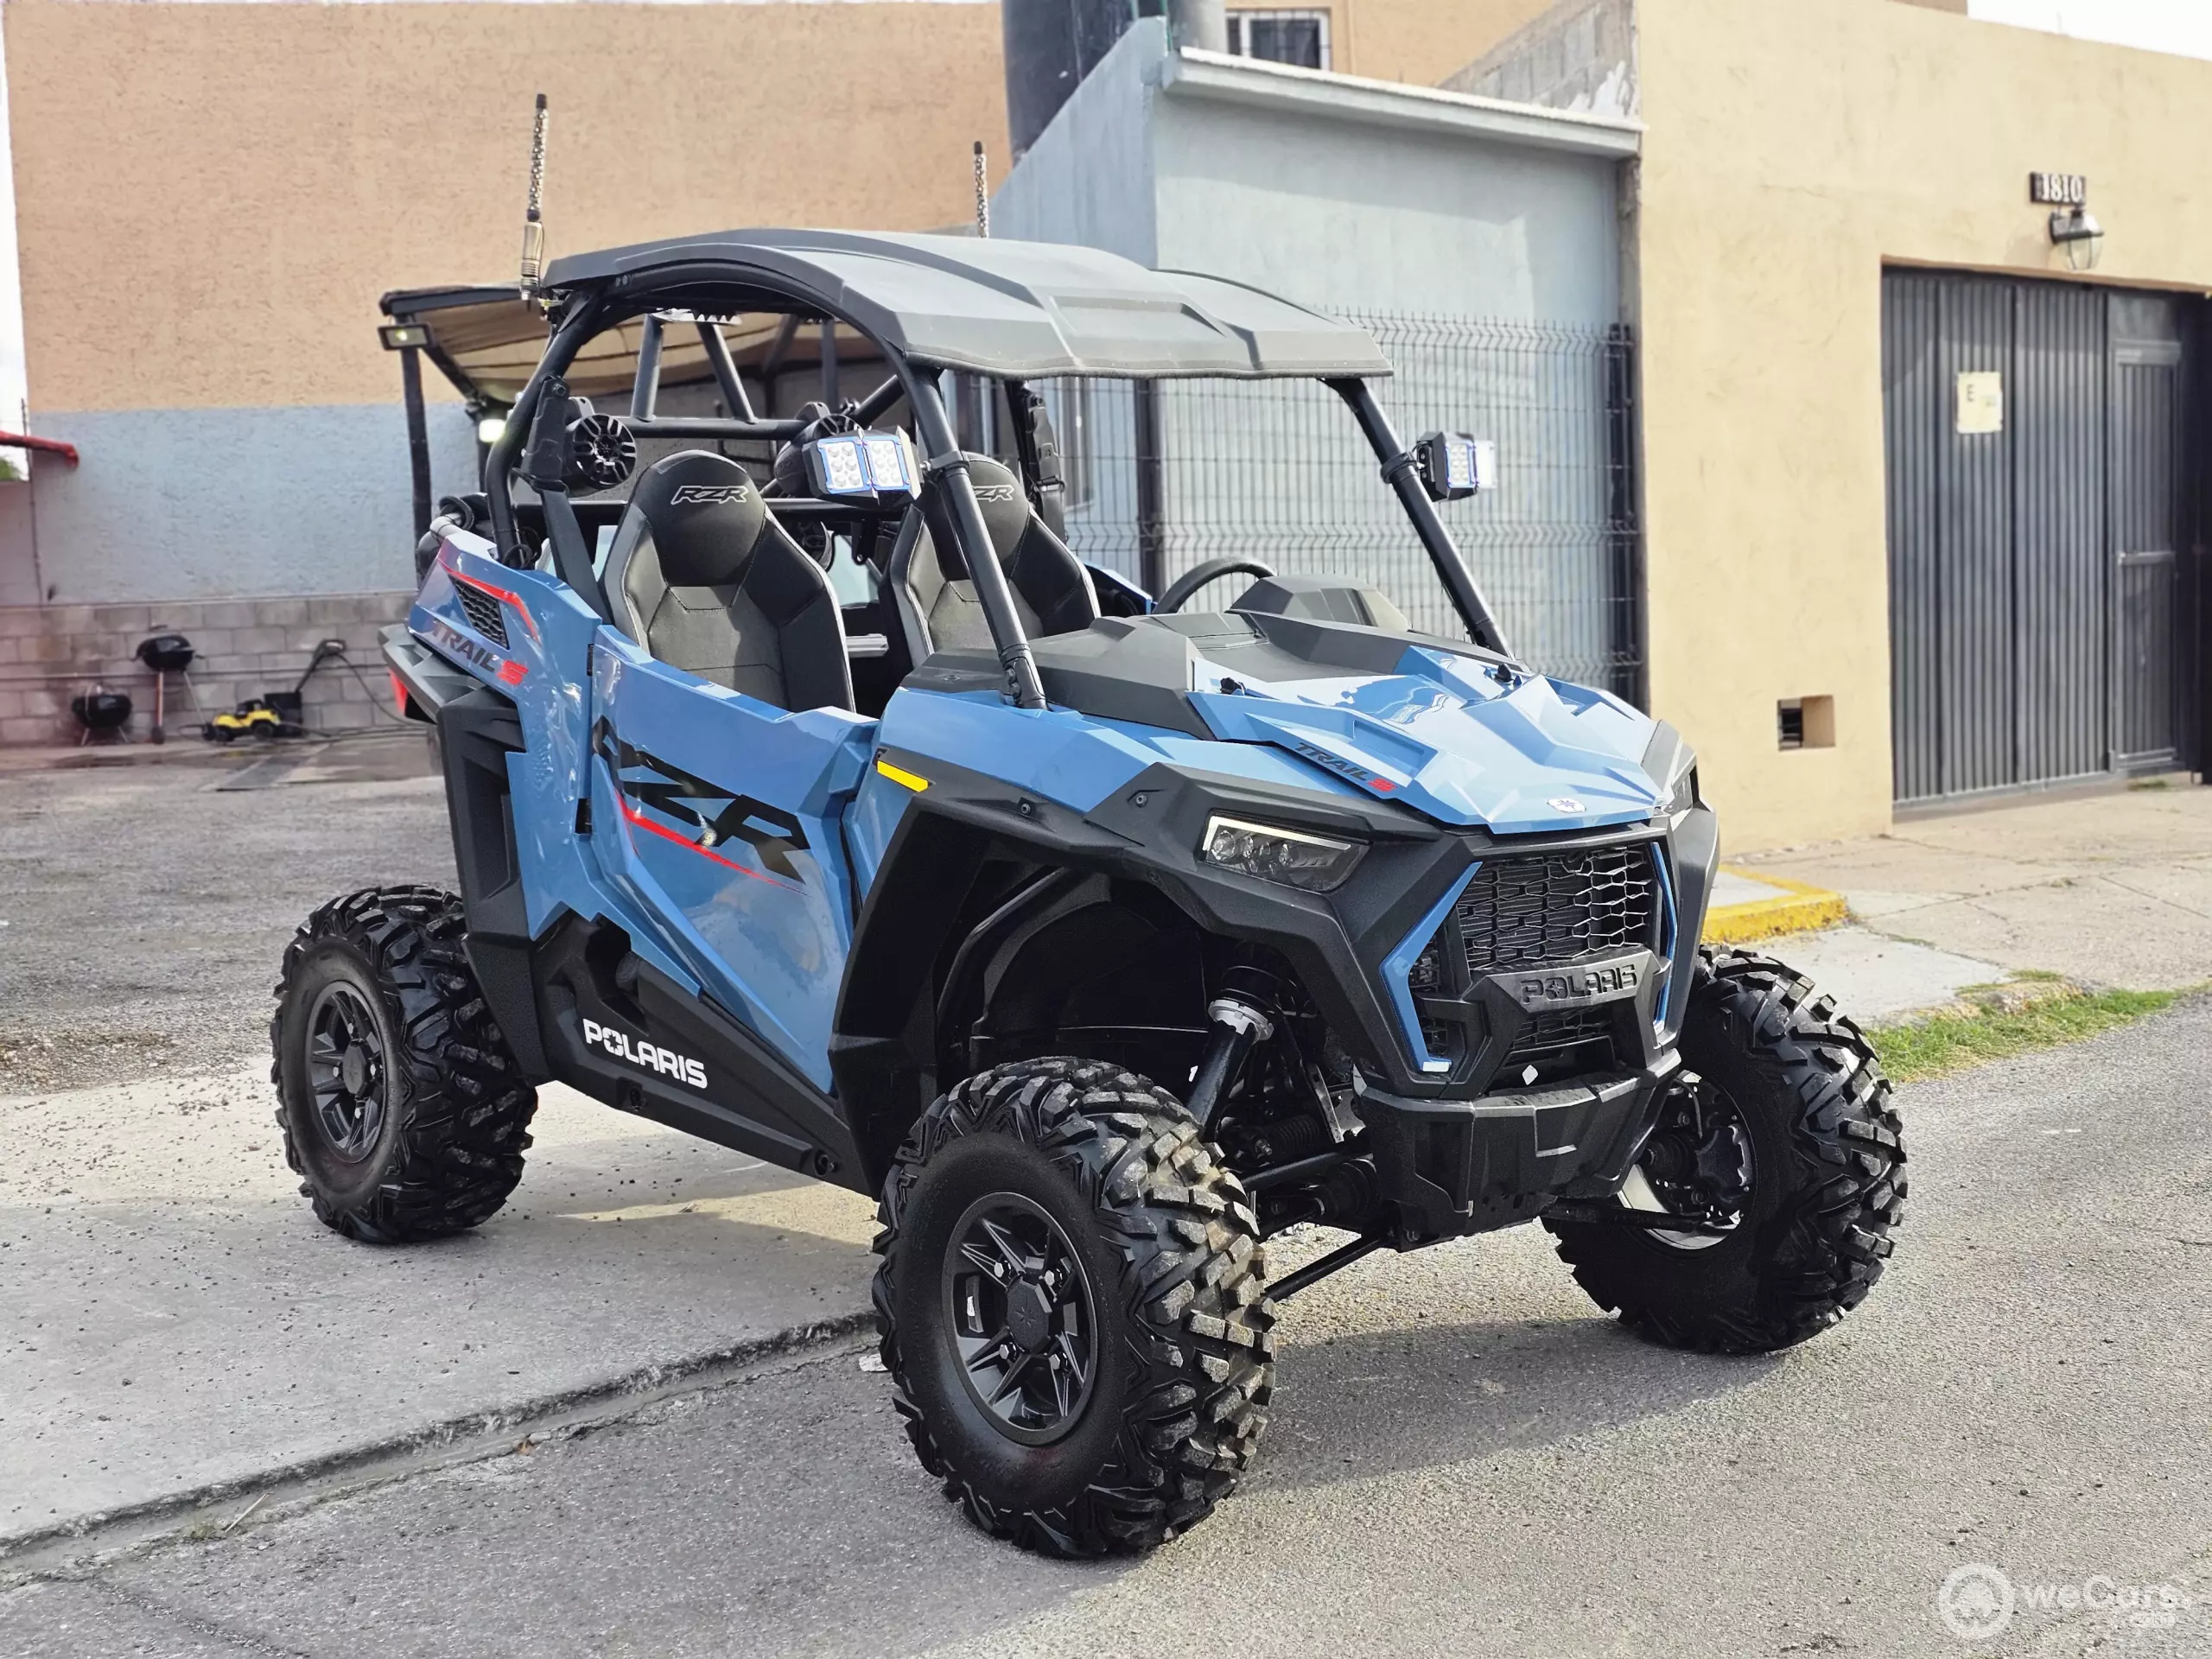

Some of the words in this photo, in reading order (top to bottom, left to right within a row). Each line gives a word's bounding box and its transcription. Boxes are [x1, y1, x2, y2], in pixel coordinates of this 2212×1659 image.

[671, 485, 748, 505] RZR
[971, 484, 1014, 502] ZR
[431, 618, 496, 673] TRAIL
[1294, 741, 1369, 781] TRAIL
[592, 715, 810, 885] RZR
[1521, 963, 1637, 1004] POLARIS
[582, 1018, 708, 1089] POLARIS
